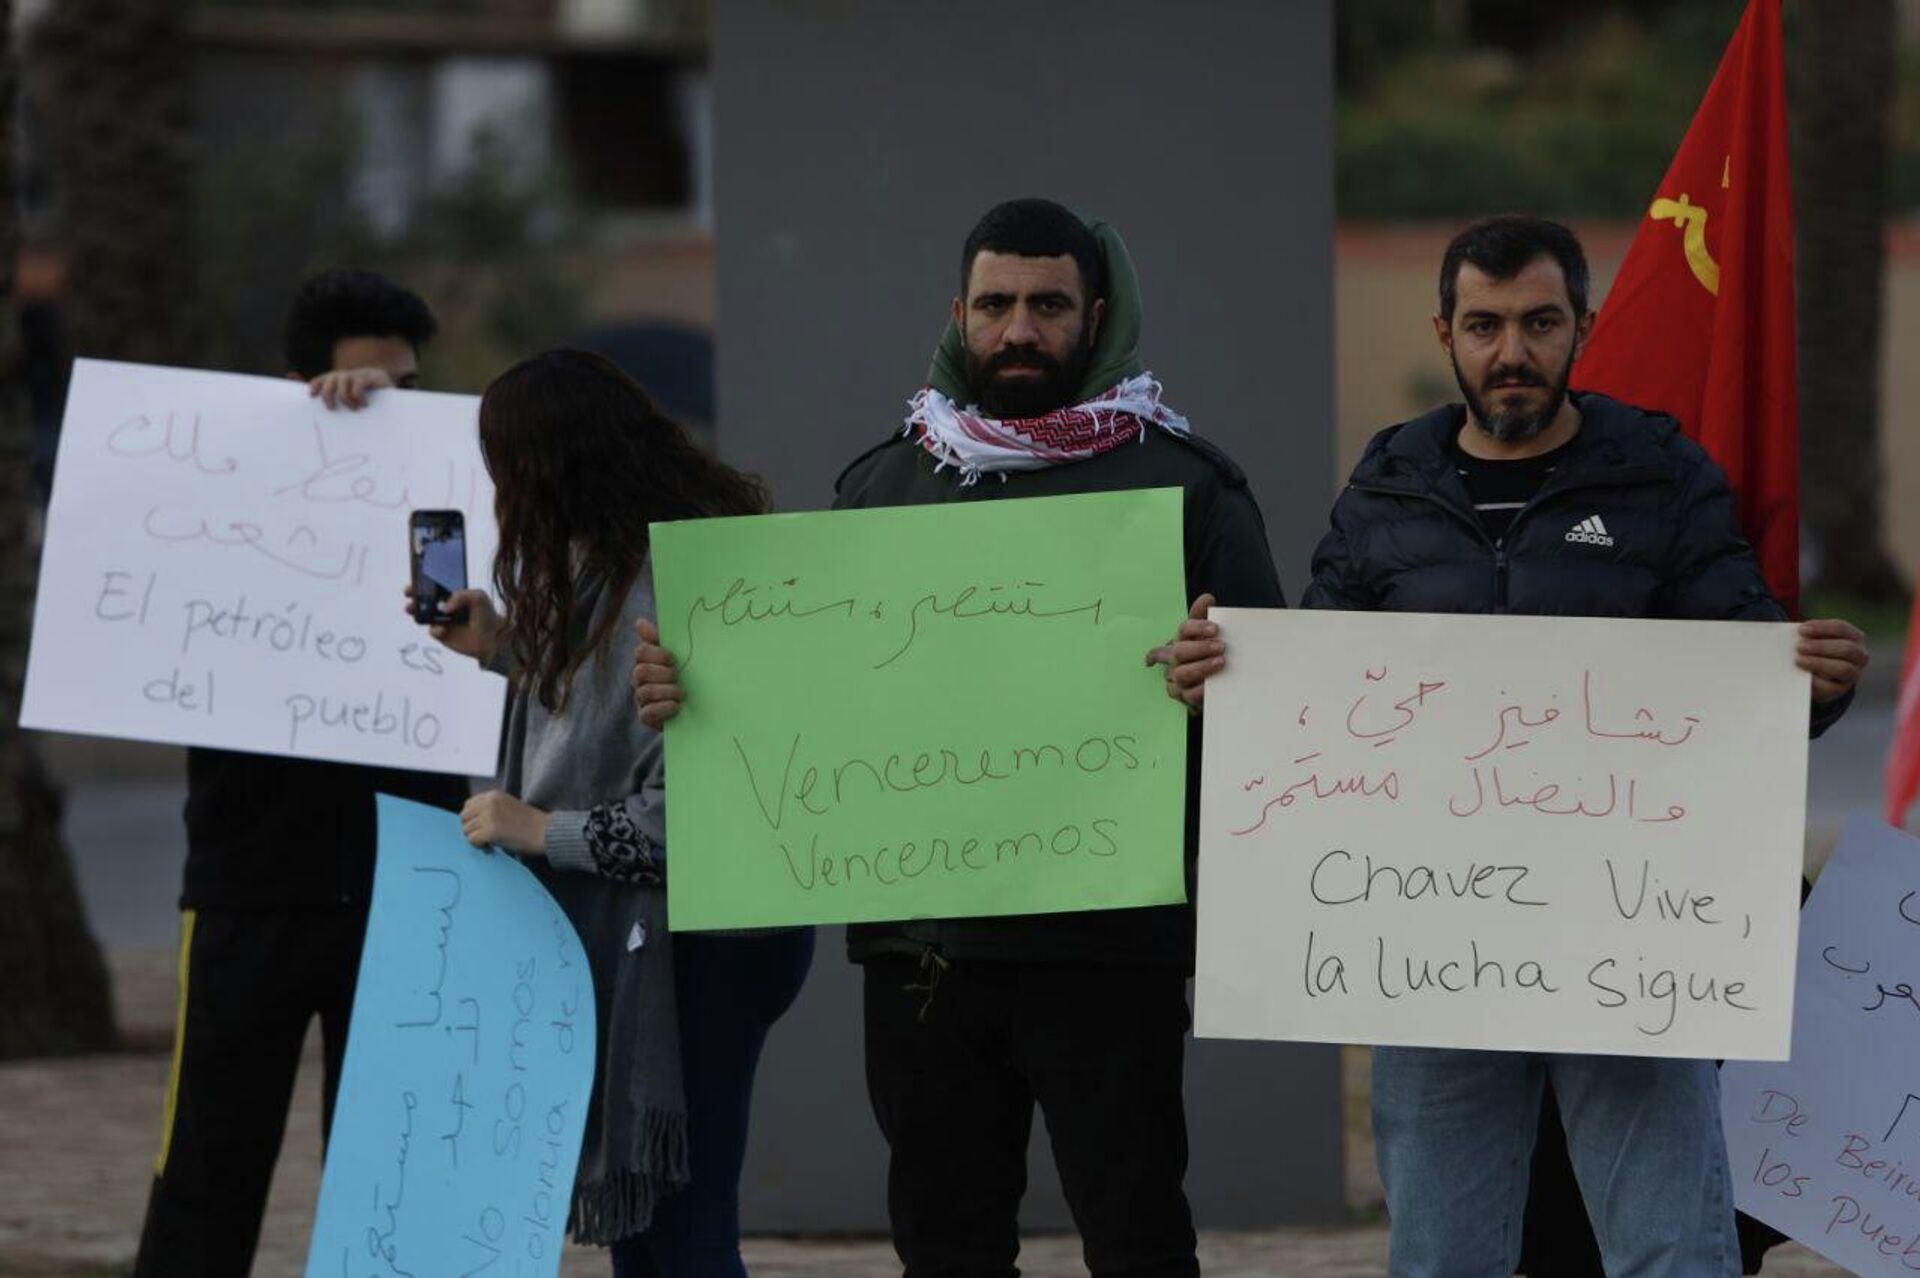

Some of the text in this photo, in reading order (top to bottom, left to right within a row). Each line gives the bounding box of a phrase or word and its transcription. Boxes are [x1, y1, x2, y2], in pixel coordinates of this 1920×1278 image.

[105, 411, 238, 476] ملك
[144, 499, 367, 587] الشعب
[1564, 530, 1615, 547] adidas
[95, 570, 446, 676] El petróleo es
[143, 667, 214, 716] del
[1463, 668, 1702, 761] تشافيز
[779, 817, 1120, 891] Venceremos
[1310, 849, 1549, 906] Chavez
[1304, 930, 1348, 998] la
[1378, 935, 1559, 999] lucha
[550, 982, 581, 1055] de
[1751, 1088, 1810, 1138] De
[1752, 1147, 1813, 1198] los
